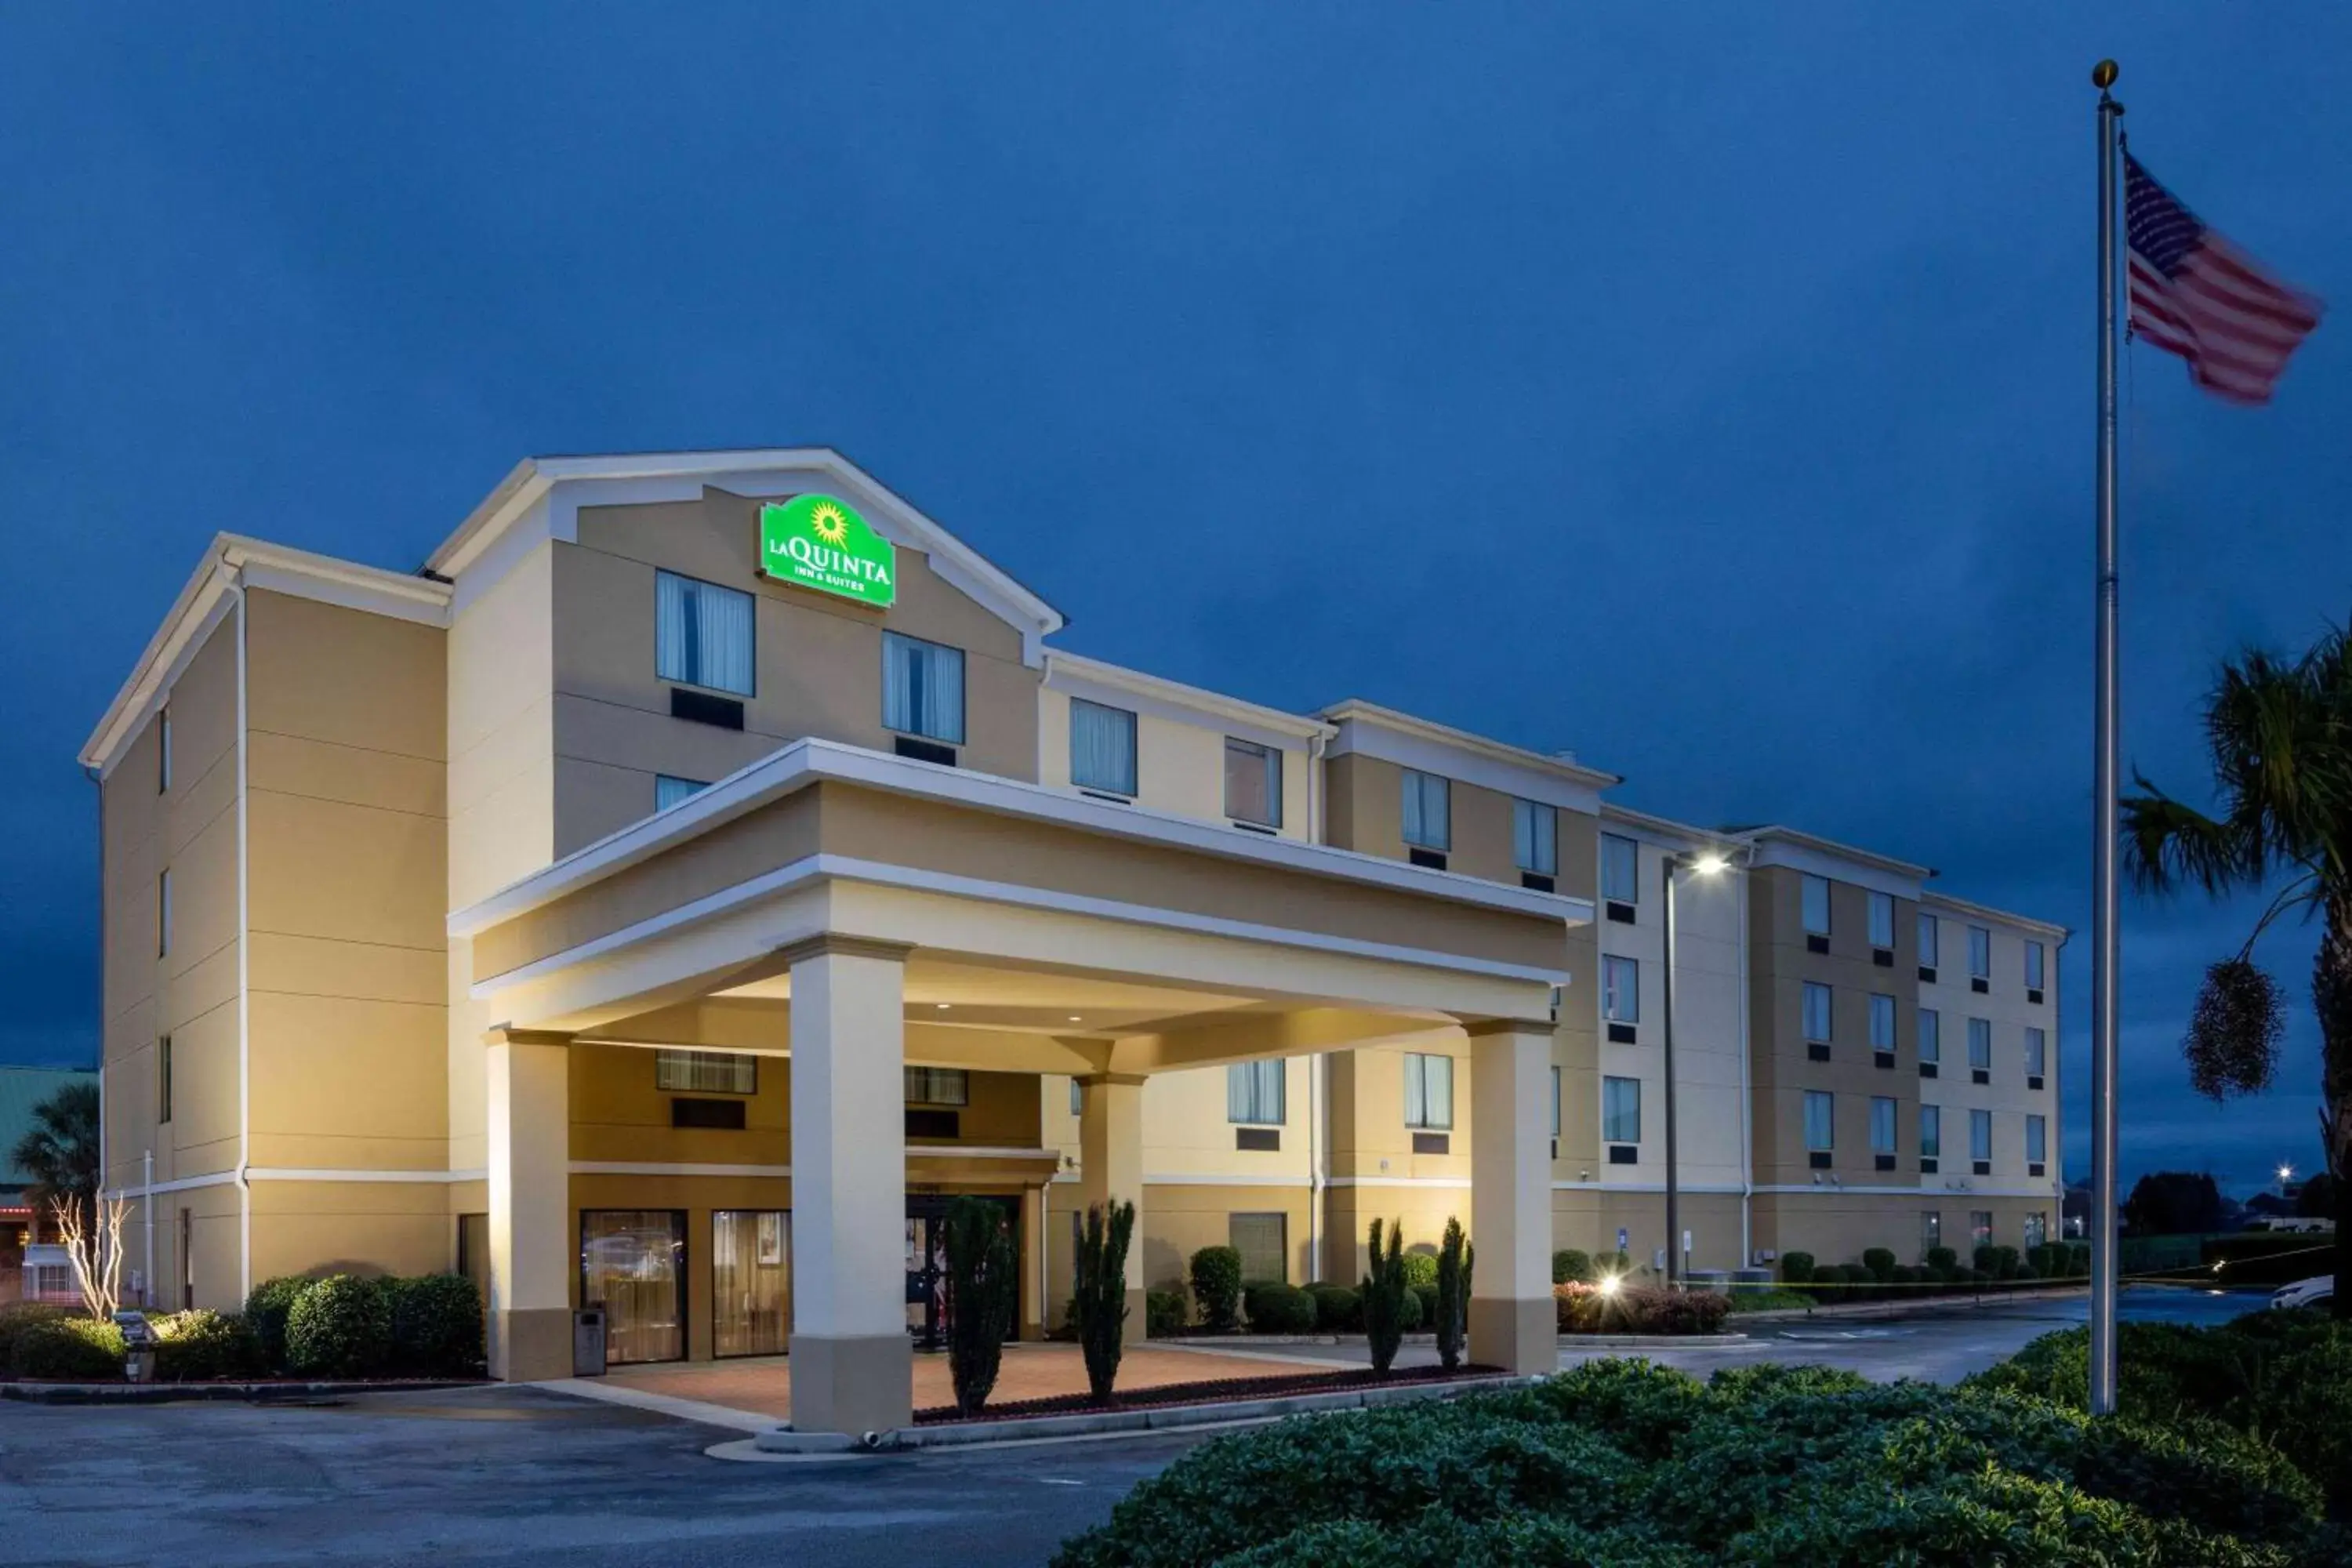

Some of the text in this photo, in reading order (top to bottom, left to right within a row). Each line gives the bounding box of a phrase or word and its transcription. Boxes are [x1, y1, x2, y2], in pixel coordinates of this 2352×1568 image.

[789, 536, 891, 585] QUINTA
[794, 564, 815, 578] INN
[826, 574, 865, 592] SUITES
